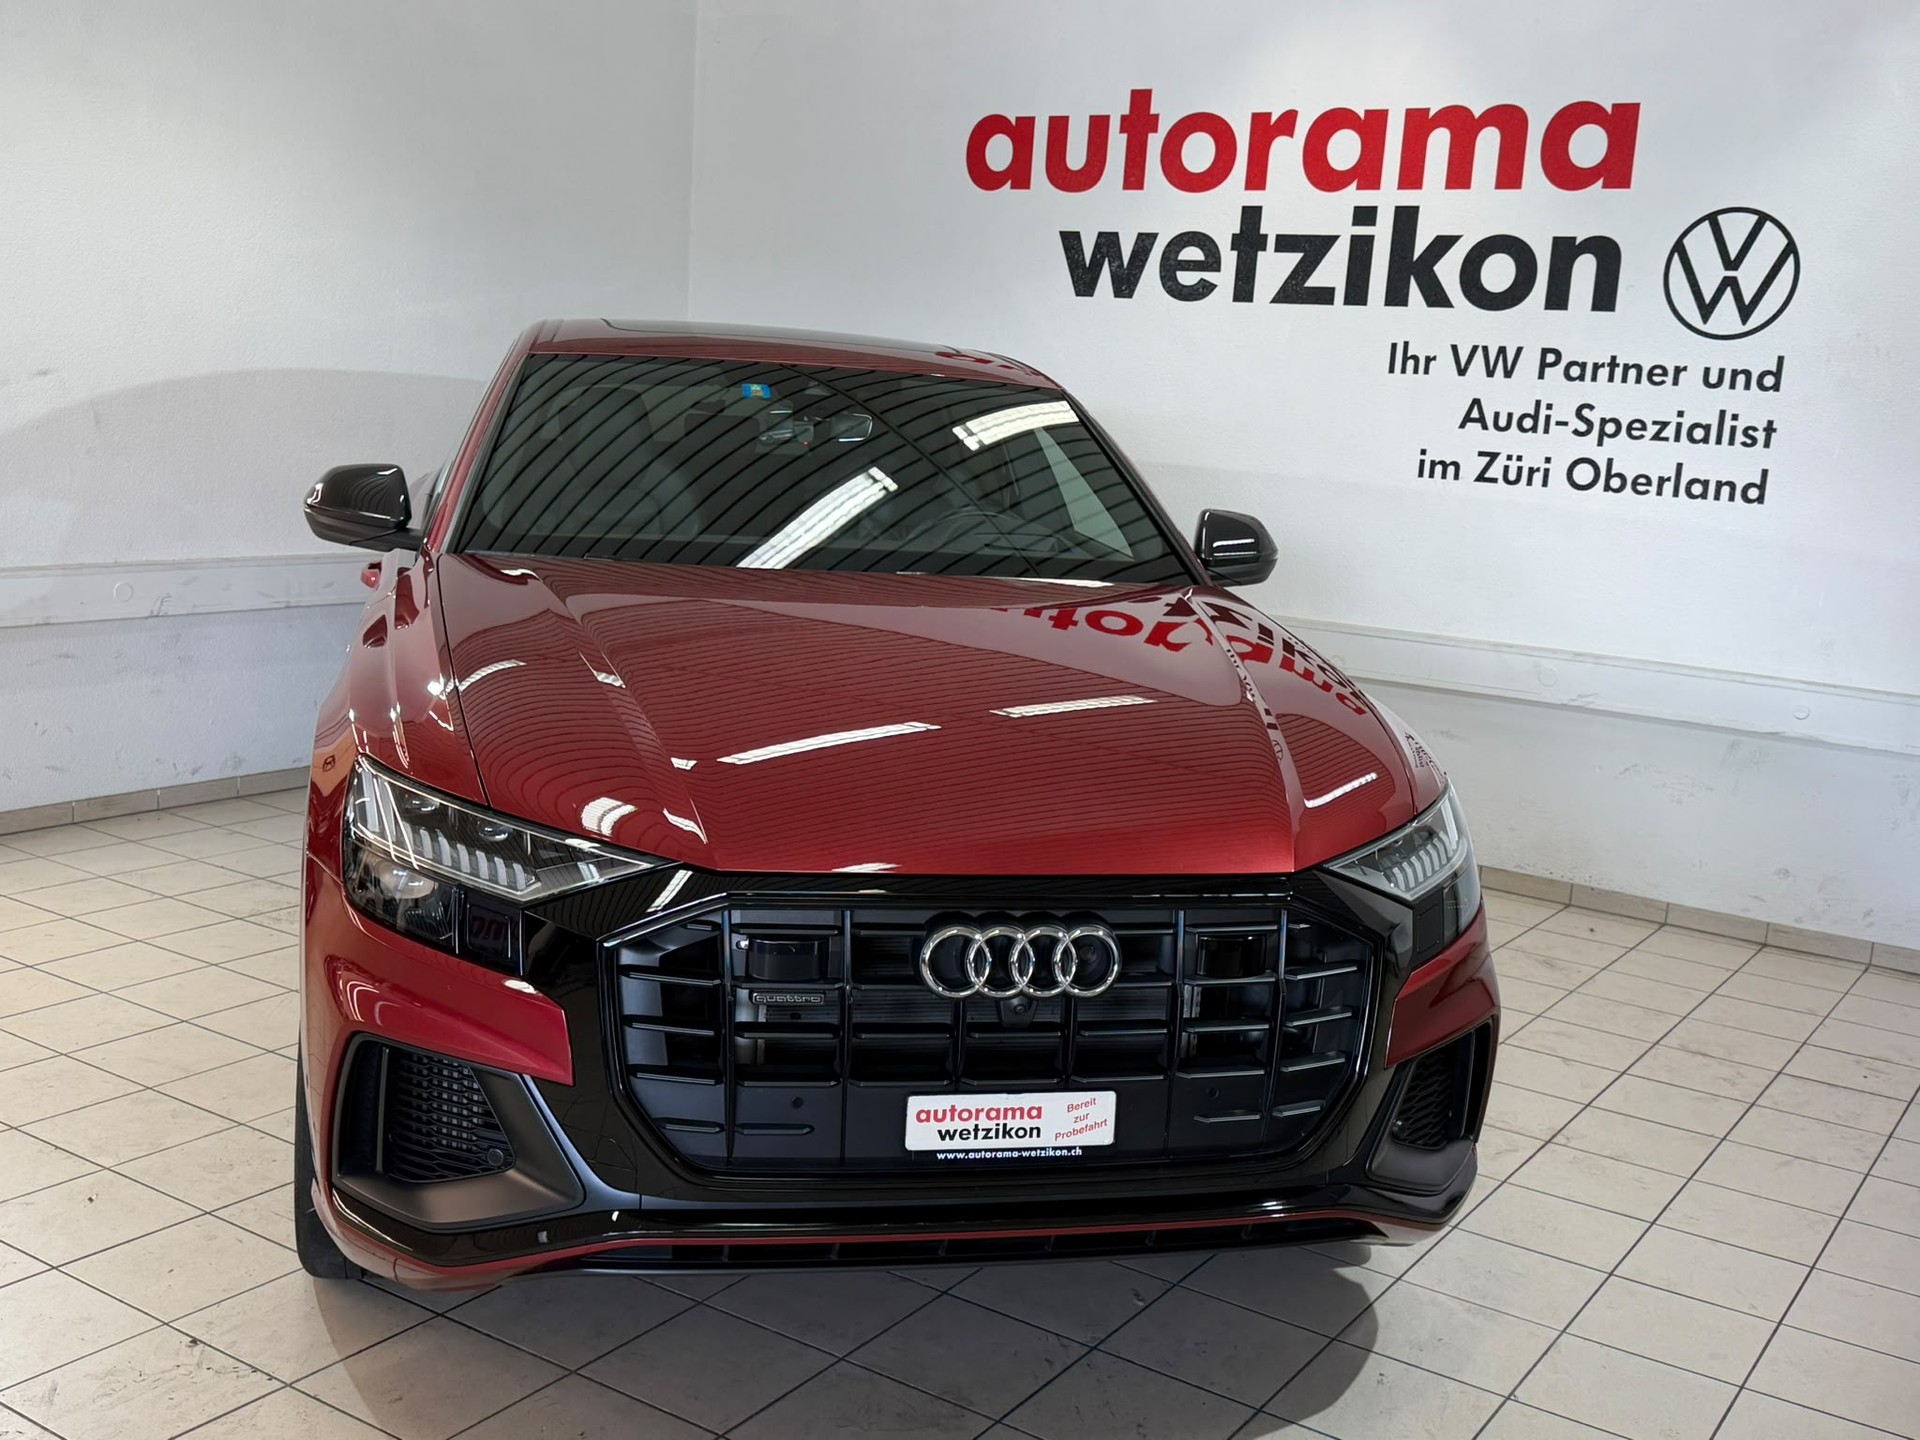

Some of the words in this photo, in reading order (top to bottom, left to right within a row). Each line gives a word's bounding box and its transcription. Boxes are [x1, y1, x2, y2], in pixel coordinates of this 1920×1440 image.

[966, 89, 1641, 194] autorama
[1058, 205, 1623, 313] wetzikon
[1387, 340, 1437, 376] Ihr
[1449, 343, 1525, 379] VW
[1536, 347, 1689, 387] Partner
[1702, 355, 1786, 393] und
[1457, 397, 1779, 450] Audi-Spezialist
[1416, 448, 1462, 481] im
[1473, 450, 1553, 488] Züri
[1565, 457, 1770, 505] Oberland
[915, 1104, 1043, 1124] autorama
[1067, 1097, 1097, 1113] Bereit
[1054, 1118, 1108, 1142] Probefahrt
[1073, 1112, 1090, 1124] zur
[937, 1122, 1042, 1142] wetzikon
[936, 1146, 1083, 1160] www.autorama-wetzikon.ch
